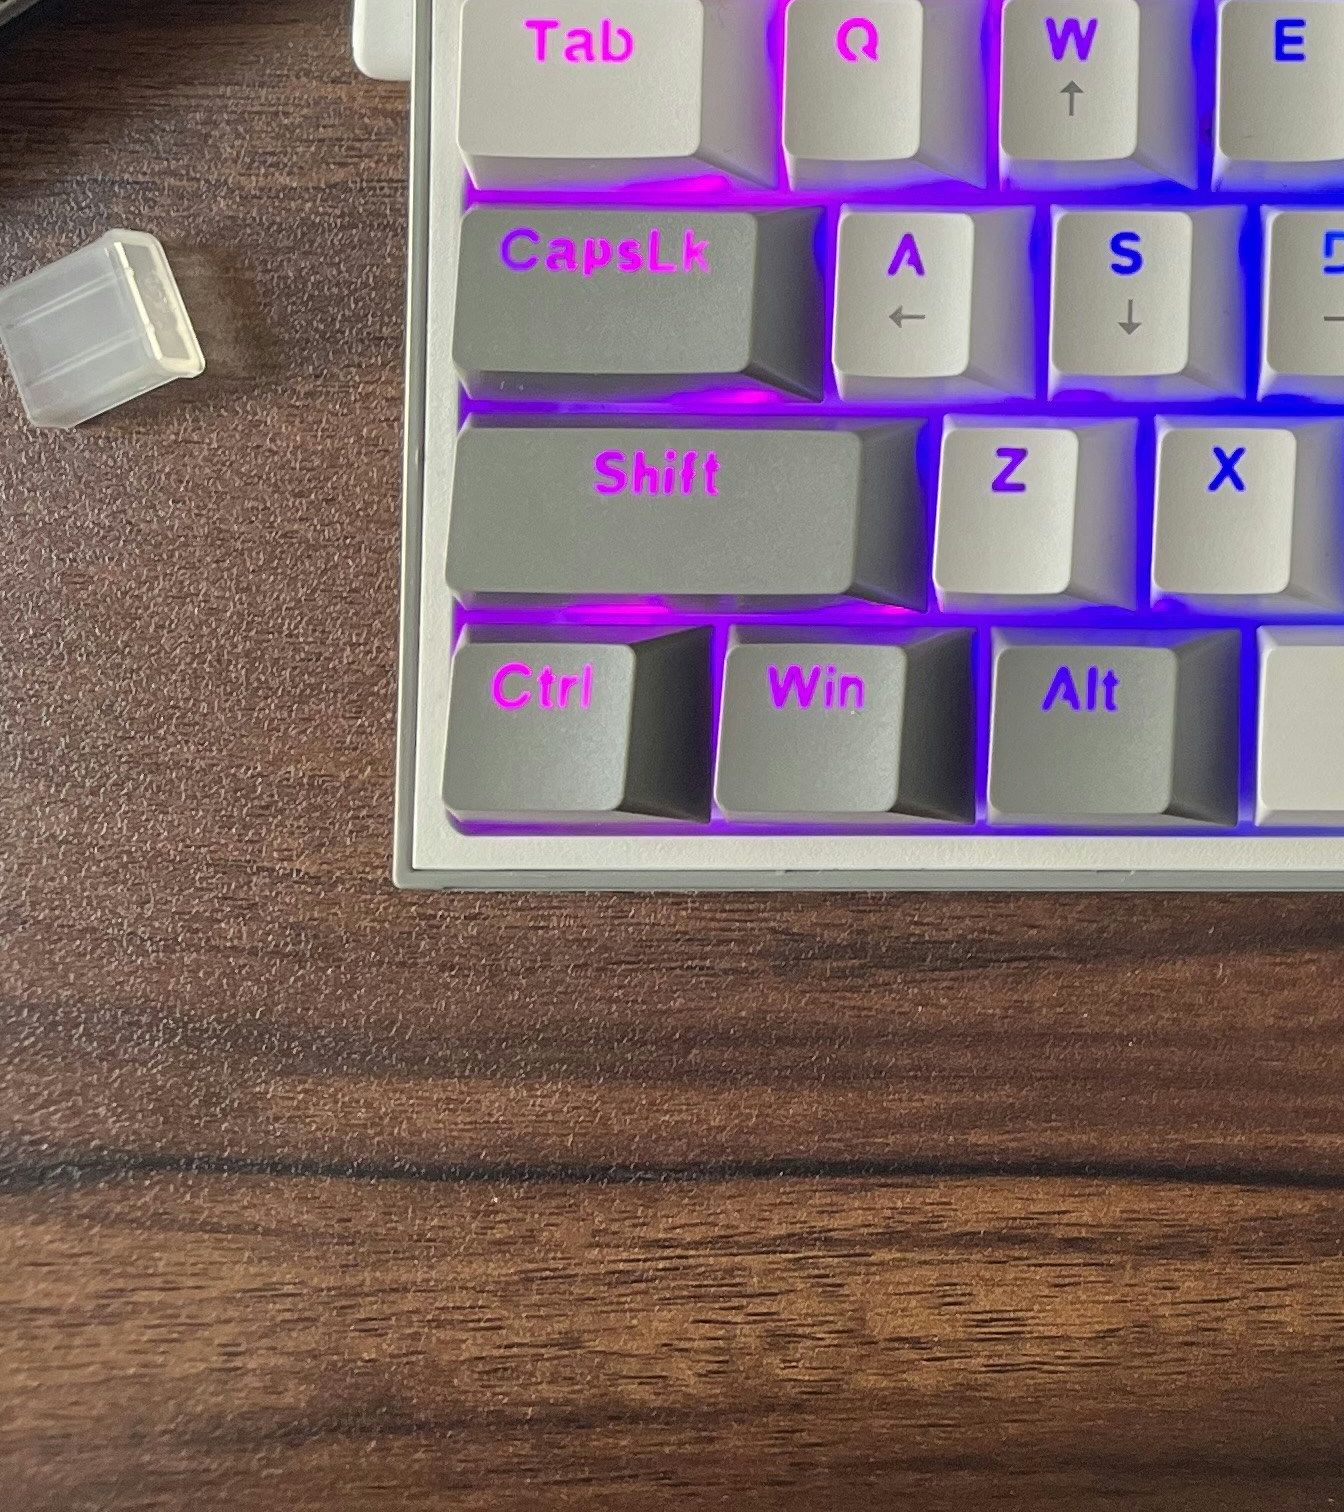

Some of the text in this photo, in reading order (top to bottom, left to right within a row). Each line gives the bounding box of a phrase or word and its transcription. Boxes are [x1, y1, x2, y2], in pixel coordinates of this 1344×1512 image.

[524, 19, 635, 63] Tab
[836, 16, 880, 62] Q
[1045, 17, 1098, 62] W
[1273, 18, 1306, 62] E
[501, 227, 712, 277] CapsLk
[887, 233, 925, 276] A
[1109, 231, 1144, 275] S
[594, 449, 720, 496] Shift
[991, 447, 1028, 493] Z
[1208, 447, 1246, 492] X
[492, 662, 594, 711] Ctrl
[767, 665, 865, 710] Win
[1041, 666, 1119, 712] Alt
